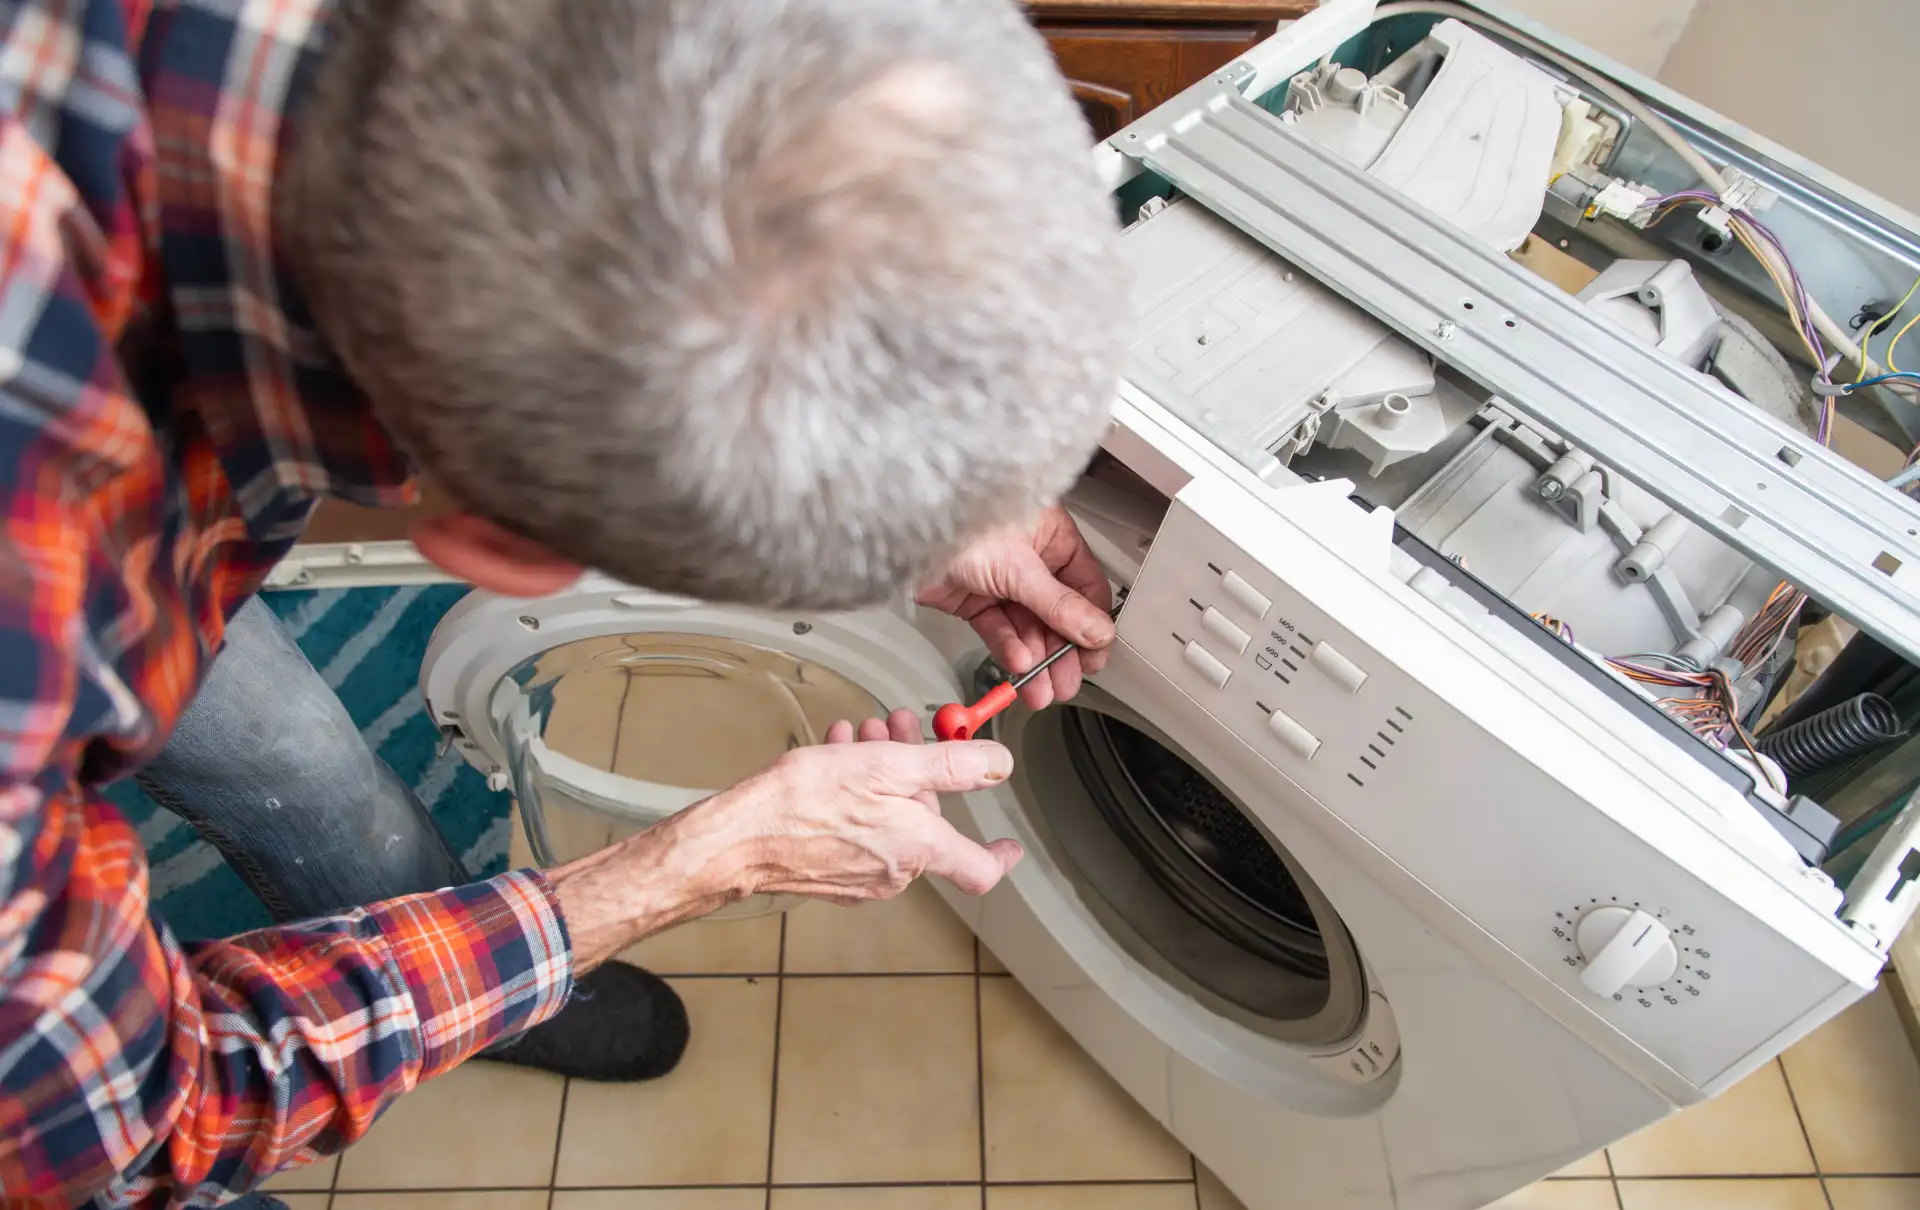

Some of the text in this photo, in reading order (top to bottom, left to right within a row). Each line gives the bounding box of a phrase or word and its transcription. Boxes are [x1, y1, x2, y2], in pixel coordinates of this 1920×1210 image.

[1279, 618, 1295, 631] 1400
[1271, 631, 1286, 645] 1000
[1265, 647, 1279, 658] 600
[1552, 927, 1564, 937] 30
[1695, 949, 1710, 958] 60
[1563, 955, 1576, 966] 30
[1695, 970, 1710, 979] 40
[1684, 985, 1700, 996] 30
